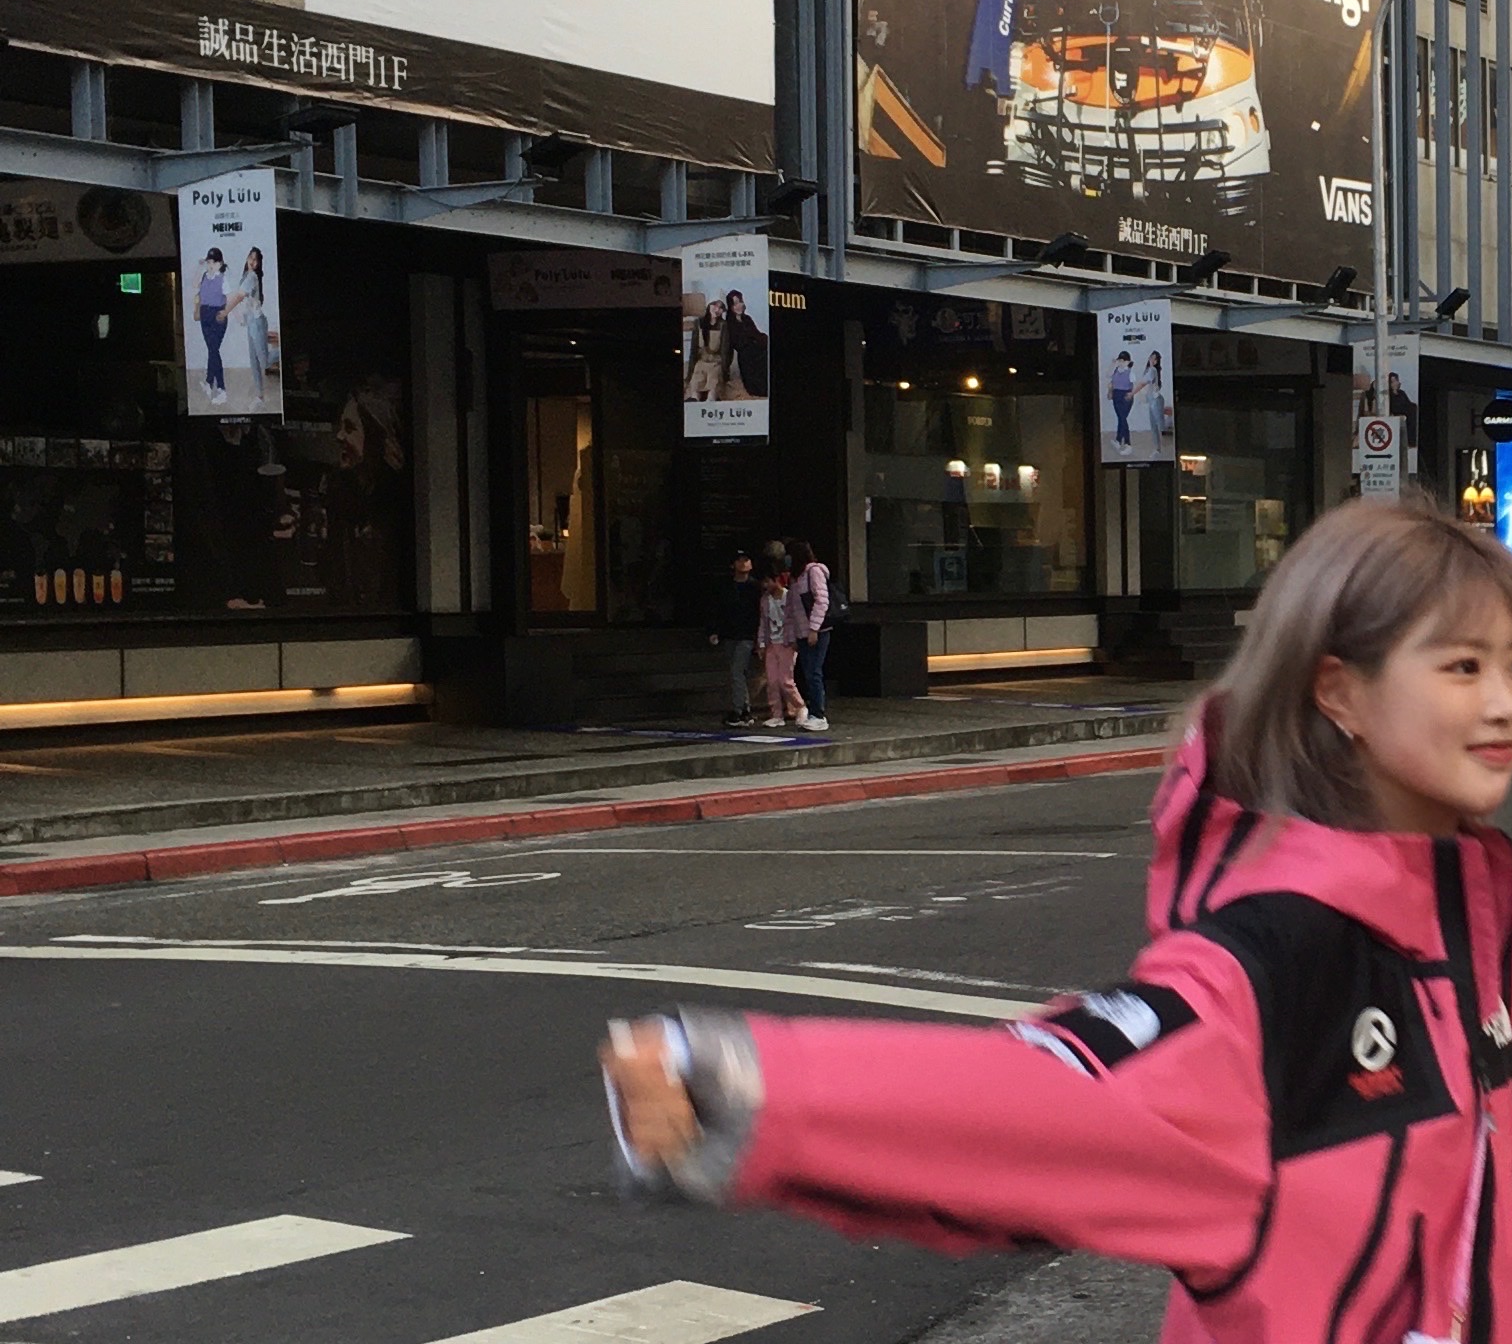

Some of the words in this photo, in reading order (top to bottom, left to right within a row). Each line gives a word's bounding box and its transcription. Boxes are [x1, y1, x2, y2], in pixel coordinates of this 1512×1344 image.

[199, 15, 408, 92] 誠品生活西門1F
[192, 190, 224, 208] Poly
[1319, 175, 1373, 227] VANS
[1107, 312, 1133, 325] Poly
[701, 408, 725, 420] Poly
